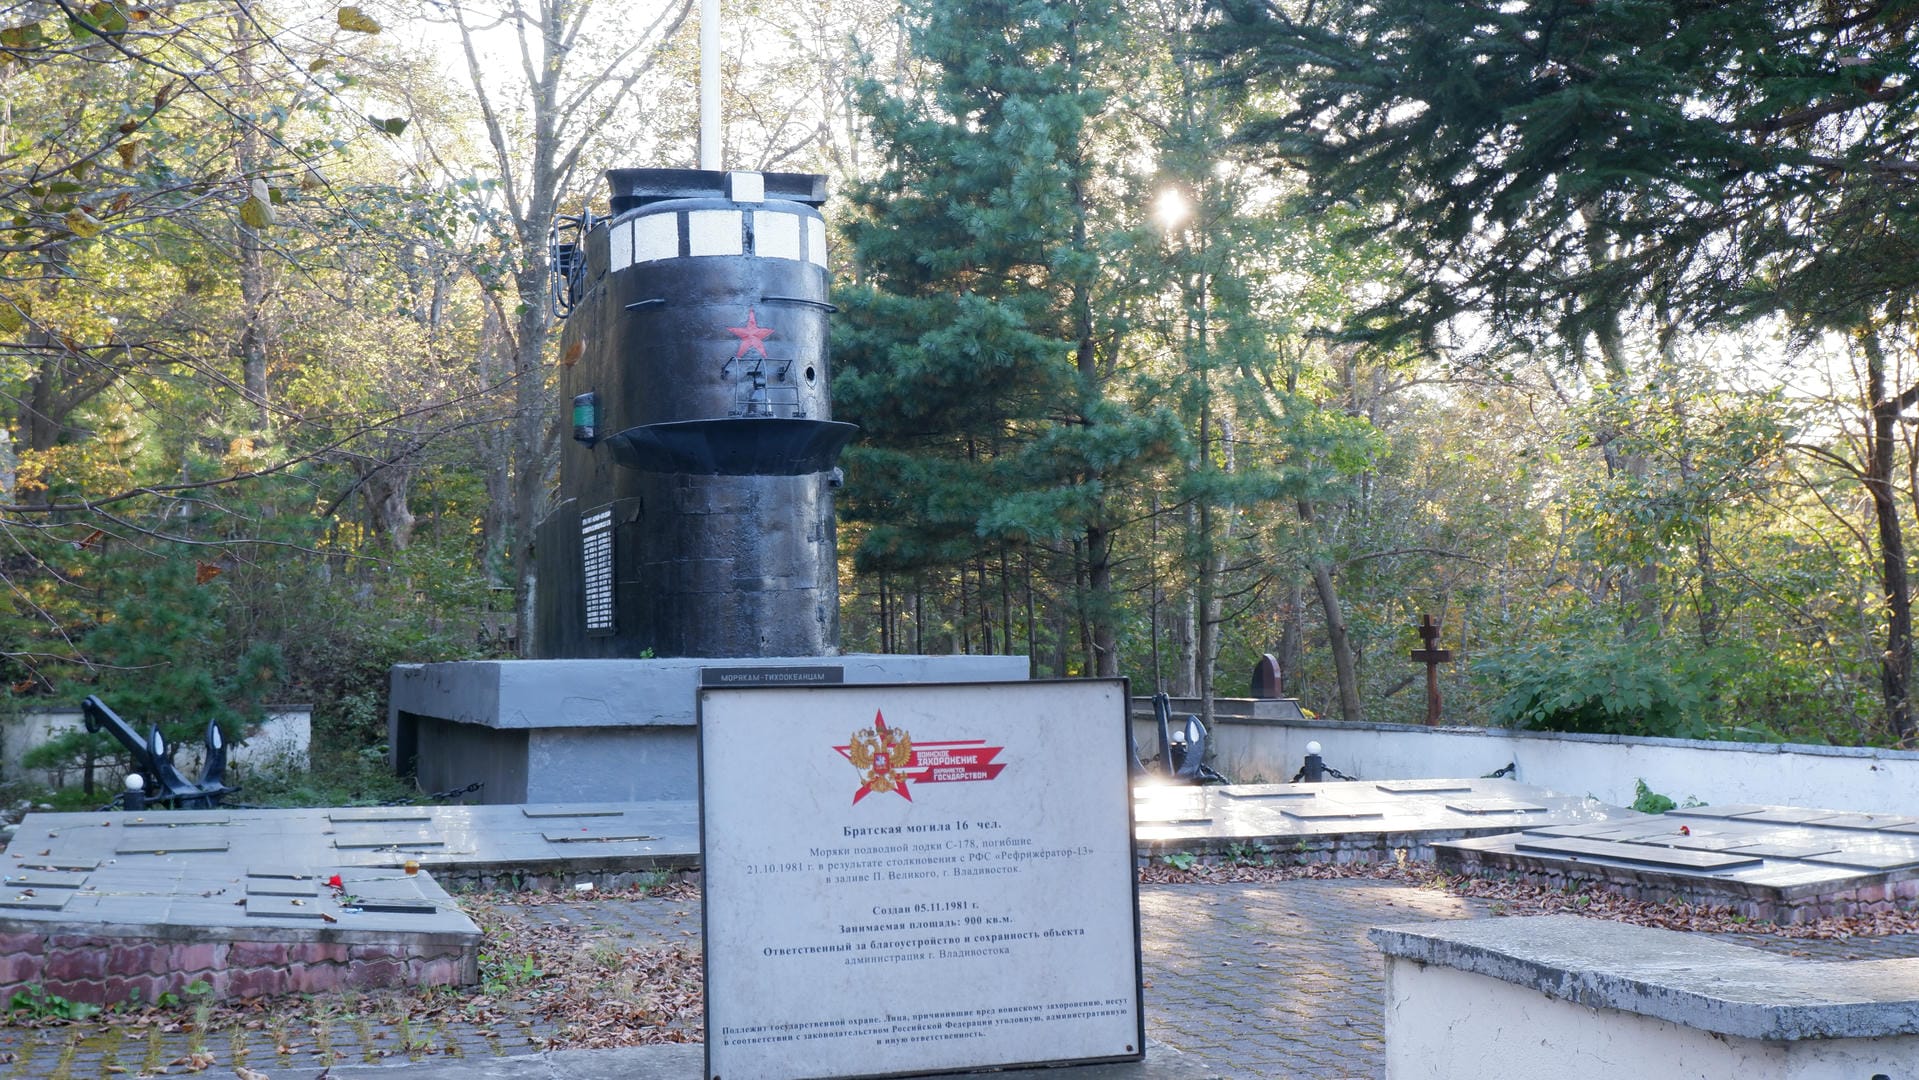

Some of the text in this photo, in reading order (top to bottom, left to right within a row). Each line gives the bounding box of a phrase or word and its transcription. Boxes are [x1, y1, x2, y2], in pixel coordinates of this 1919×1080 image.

[721, 673, 825, 682] МОРЯКАМ-ТИХООКЕАНЦАМ
[917, 756, 978, 767] ЗАХОРОНЕНИЕ
[934, 772, 988, 781] ГОСУДАРСТВОМ
[843, 820, 1002, 838] Братская могила 16 чел.
[809, 836, 1033, 859] Моряки подводной лодки С-178, погибшие
[746, 862, 803, 875] 21.10.1981
[818, 863, 824, 871] в
[827, 860, 883, 873] результате
[886, 856, 957, 867] столкновения
[960, 855, 966, 863] с
[969, 852, 992, 863] РФС
[995, 845, 1094, 862] «Рефрижератор-13»
[826, 875, 832, 884] в
[834, 873, 870, 884] заливе
[888, 868, 940, 881] Великого,
[943, 869, 951, 877] г.
[953, 865, 1022, 877] Владивосток.
[872, 901, 980, 916] Создан 05.11.1981 г.
[839, 915, 1013, 934] Занимаемая площадь: 900 кв.м.
[763, 928, 1085, 957] Ответственный за благоустройство и сохранность объекта
[844, 947, 1010, 966] администрация г. Владивостока
[722, 1025, 767, 1035] Подлежит
[770, 1018, 846, 1032] государственной
[884, 1014, 910, 1023] Лица,
[912, 1009, 973, 1022] причинившие
[976, 1007, 996, 1017] вред
[998, 1004, 1043, 1014] воинскому
[1047, 1000, 1103, 1010] захоронению,
[1105, 997, 1128, 1006] несут
[732, 1034, 793, 1045] соответствии
[803, 1027, 889, 1040] законодательством
[892, 1022, 942, 1033] Российской
[945, 1018, 993, 1030] Федерации
[995, 1014, 1044, 1027] уголовную,
[1046, 1008, 1128, 1022] административную
[885, 1035, 909, 1046] иную
[910, 1030, 987, 1043] ответственность.
